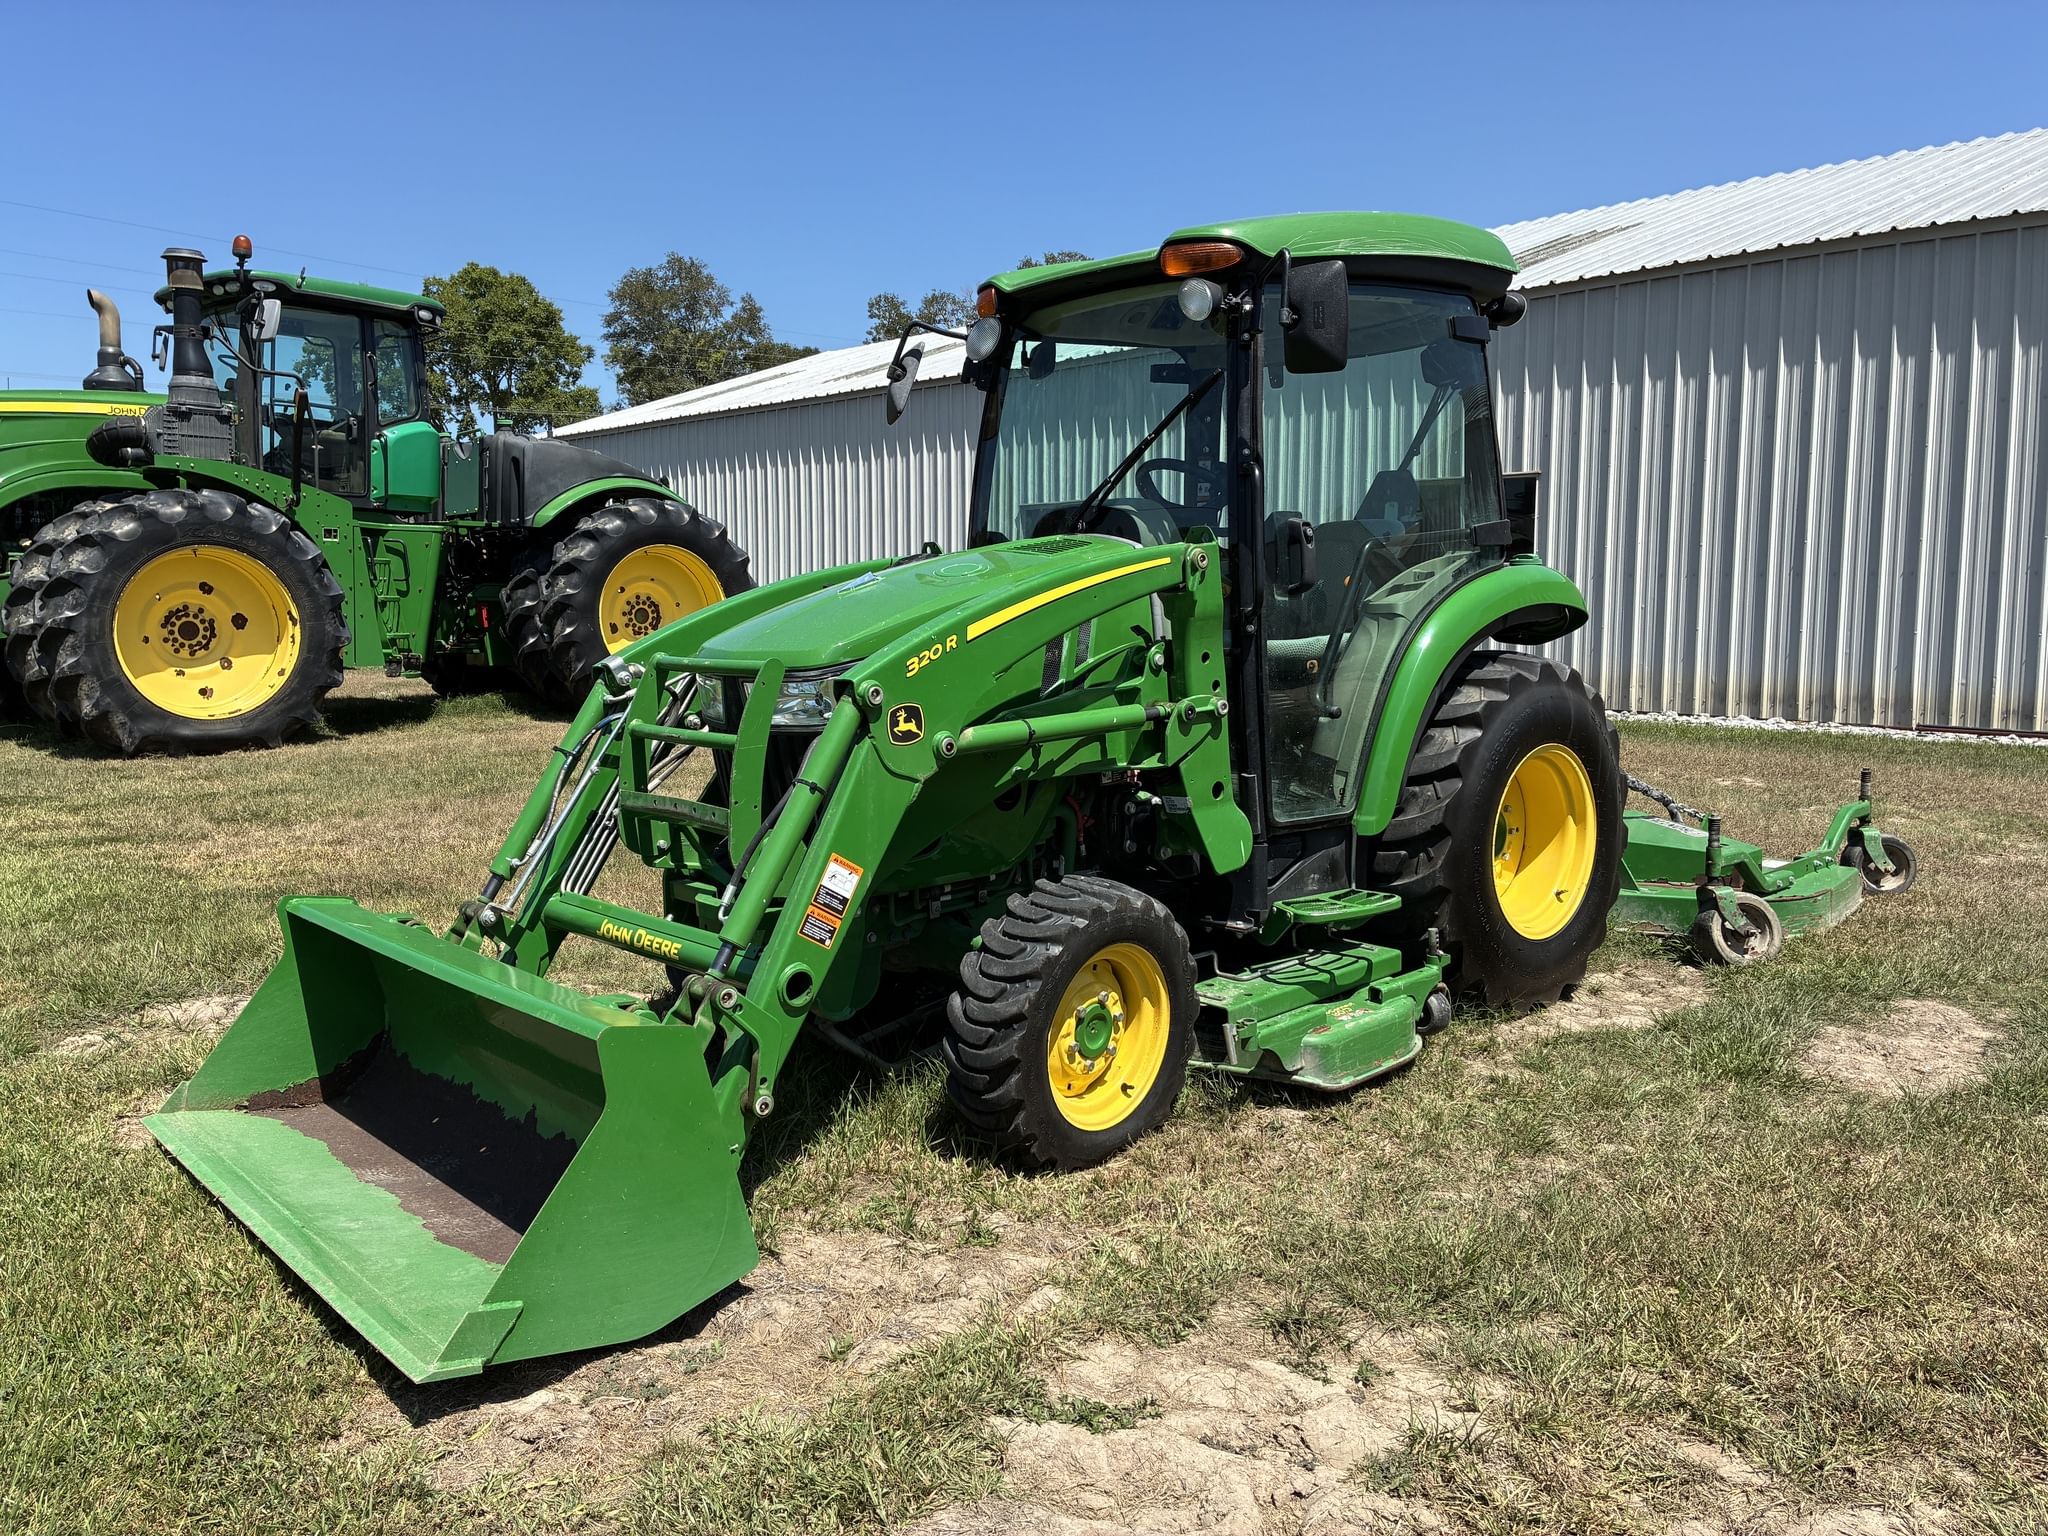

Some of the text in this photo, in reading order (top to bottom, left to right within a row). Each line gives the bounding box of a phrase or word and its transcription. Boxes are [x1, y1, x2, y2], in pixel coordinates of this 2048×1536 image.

[107, 405, 137, 416] JOHN
[905, 634, 958, 678] 320 R
[596, 918, 683, 961] JOHN DEERE
